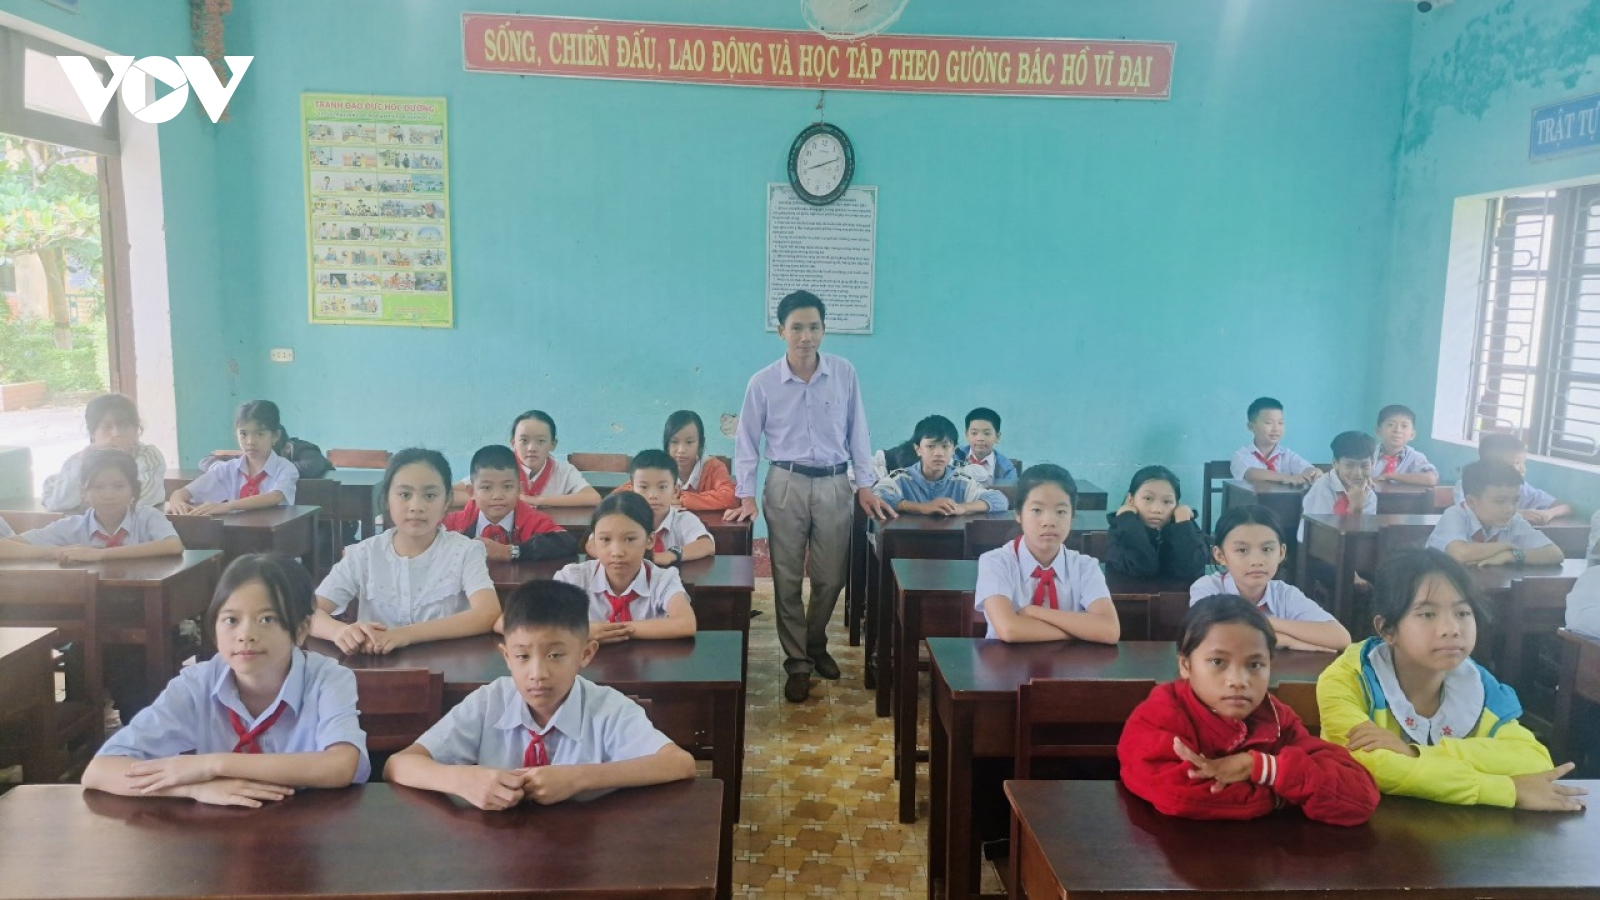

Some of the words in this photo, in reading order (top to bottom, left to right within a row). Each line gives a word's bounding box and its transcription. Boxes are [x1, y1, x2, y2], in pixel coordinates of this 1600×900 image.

[484, 21, 542, 66] SỐNG,
[549, 26, 611, 67] CHIẾN
[616, 28, 662, 73] ĐẤU,
[669, 38, 706, 72] LAO
[712, 36, 764, 80] ĐỘNG
[768, 38, 794, 77] VÀ
[798, 44, 840, 83] HỌC
[845, 43, 883, 84] TẬP
[888, 49, 940, 82] THEO
[946, 46, 1011, 84] GƯƠNG
[1017, 47, 1056, 86] BÁC
[1060, 46, 1090, 86] HỒ
[1093, 50, 1114, 87] VĨ
[1117, 56, 1154, 92] ĐẠI
[315, 100, 343, 110] TRANH
[1537, 107, 1575, 147] TRẬT
